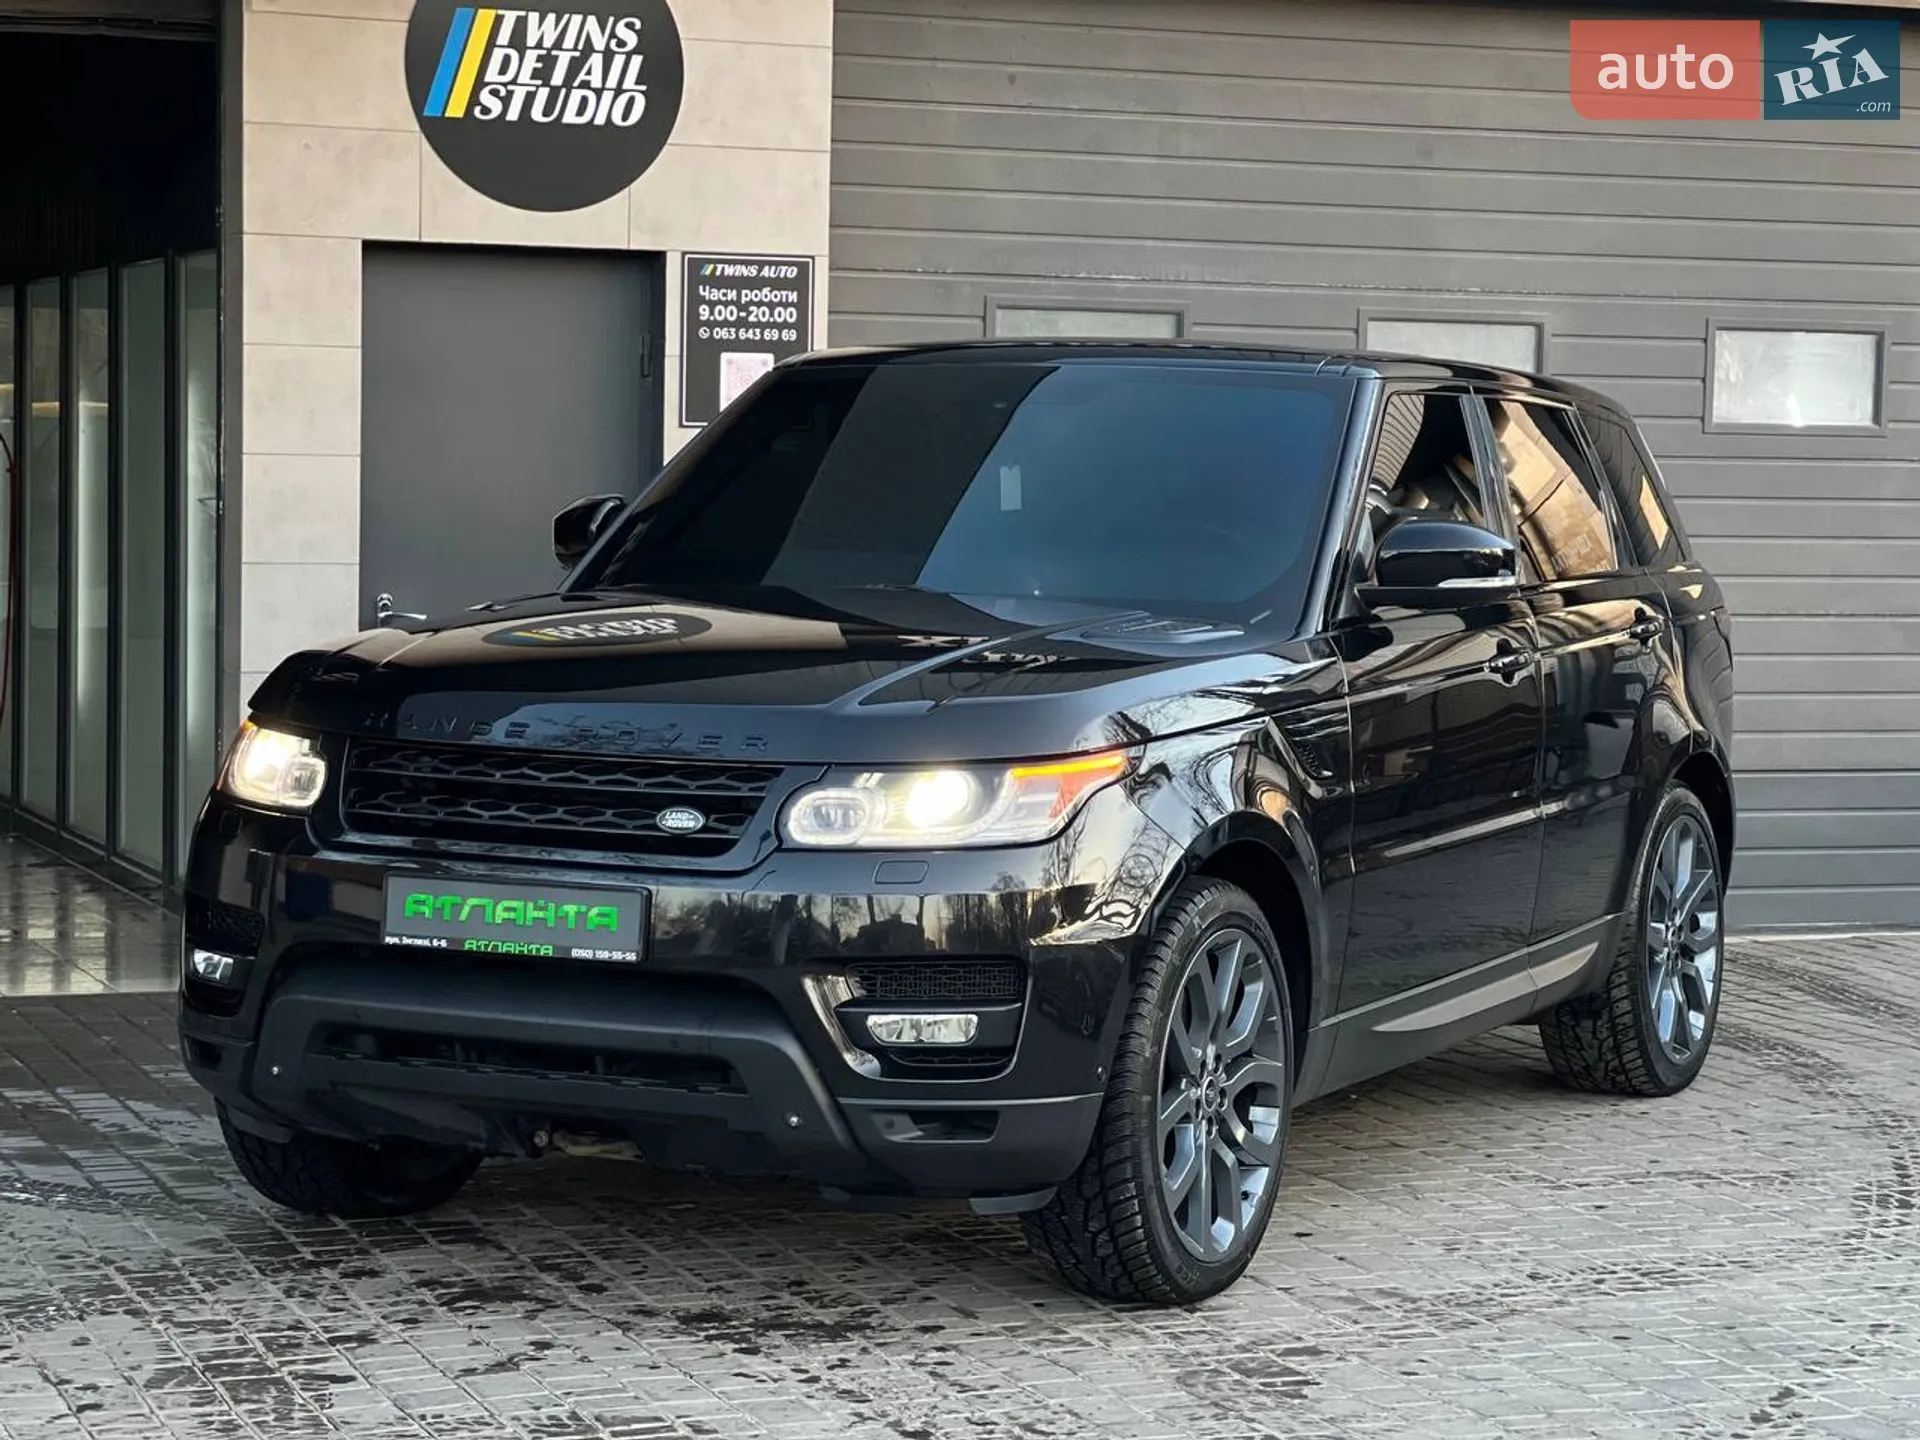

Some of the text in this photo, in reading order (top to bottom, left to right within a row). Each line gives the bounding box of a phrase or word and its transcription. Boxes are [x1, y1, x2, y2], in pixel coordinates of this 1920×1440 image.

[495, 9, 642, 53] TWINS
[483, 48, 647, 92] DETAIL
[473, 86, 647, 127] STUDIO
[715, 264, 798, 278] TWINS AUTO
[698, 285, 798, 304] Часи роботи
[698, 304, 797, 323] 9.00-20.00
[713, 327, 797, 341] 063 643 69 69
[403, 892, 619, 933] АТЛАНТА
[464, 939, 553, 957] АТЛАНТА
